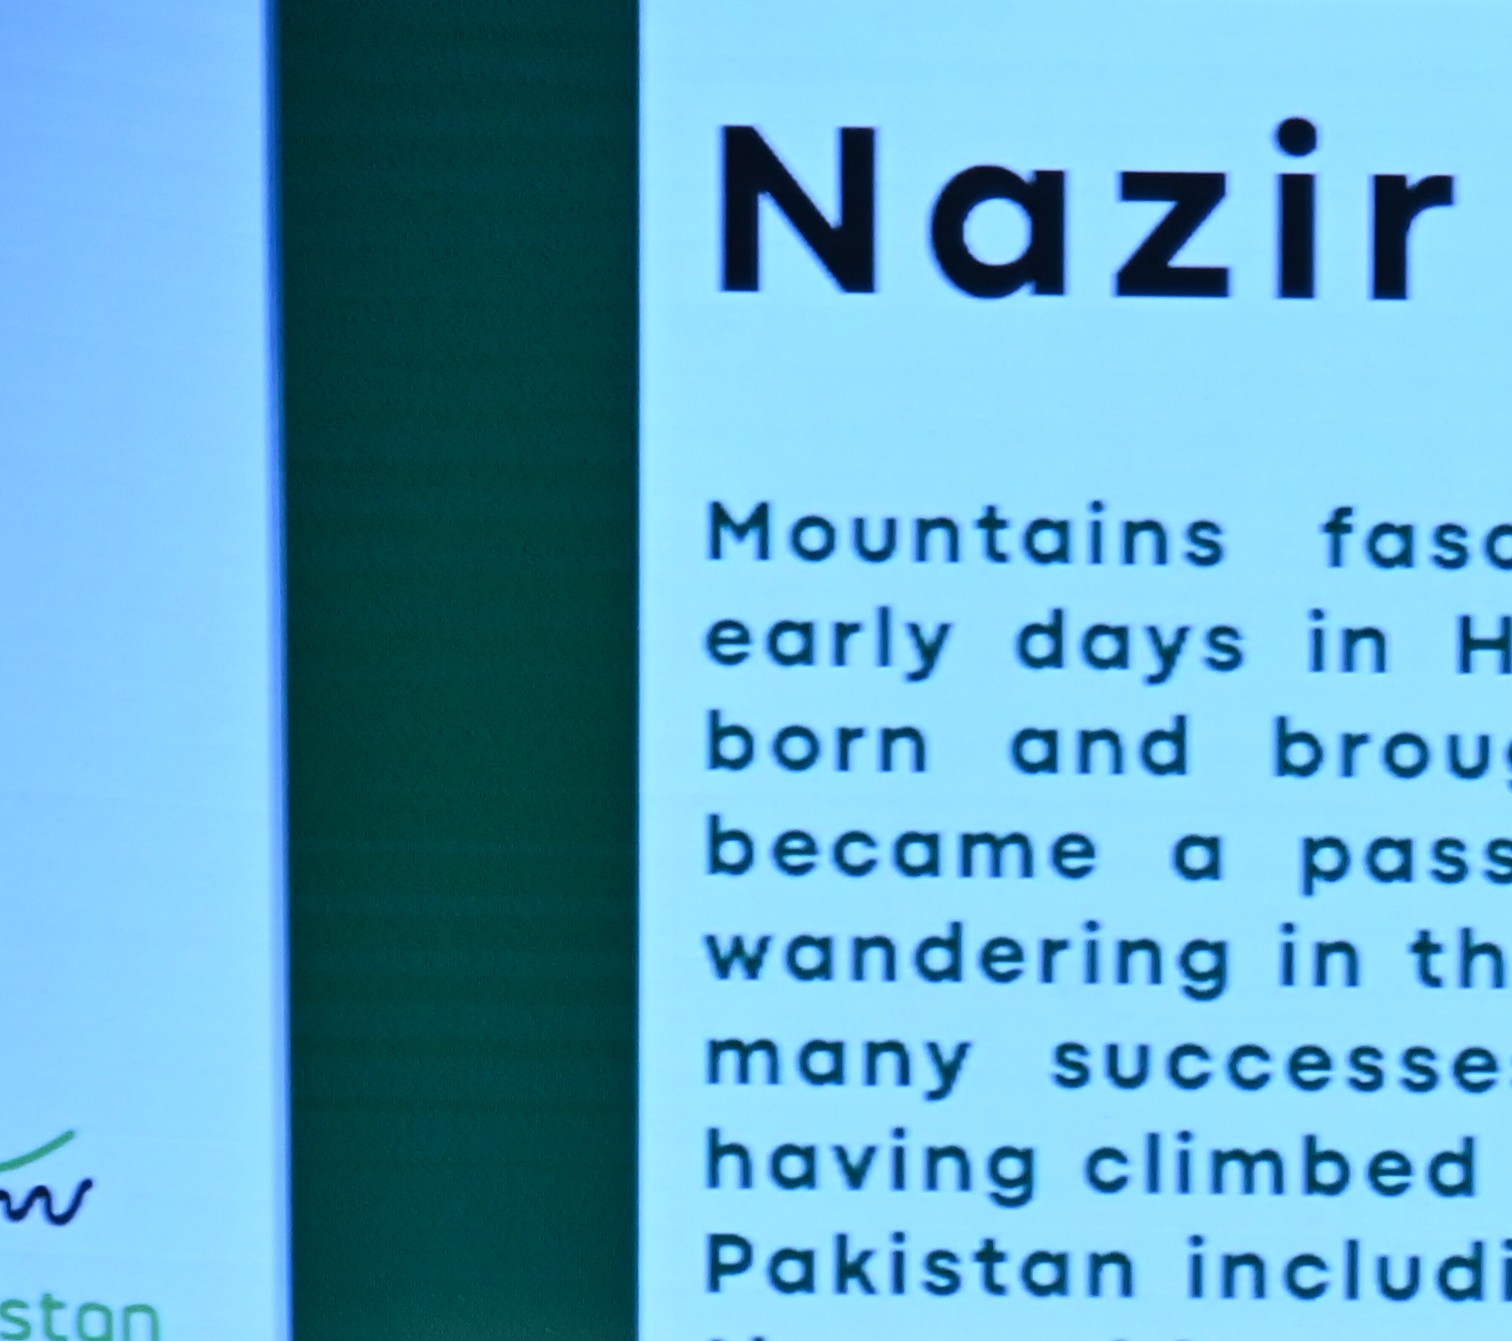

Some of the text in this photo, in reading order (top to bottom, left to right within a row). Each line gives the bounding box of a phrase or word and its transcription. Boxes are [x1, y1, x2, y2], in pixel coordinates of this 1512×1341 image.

[717, 114, 1458, 304] Nazir
[705, 497, 1227, 571] Mountains
[702, 603, 954, 686] early
[1012, 605, 1247, 689] days
[1306, 605, 1389, 676] in
[704, 706, 929, 776] born
[1007, 712, 1190, 780] and
[704, 811, 1099, 883] became
[1169, 831, 1225, 885] a
[701, 917, 1232, 1005] wandering
[1277, 919, 1363, 990] in
[704, 1036, 975, 1105] many
[703, 1124, 1039, 1212] having
[1081, 1127, 1479, 1201] climbed
[704, 1228, 1137, 1301] Pakistan
